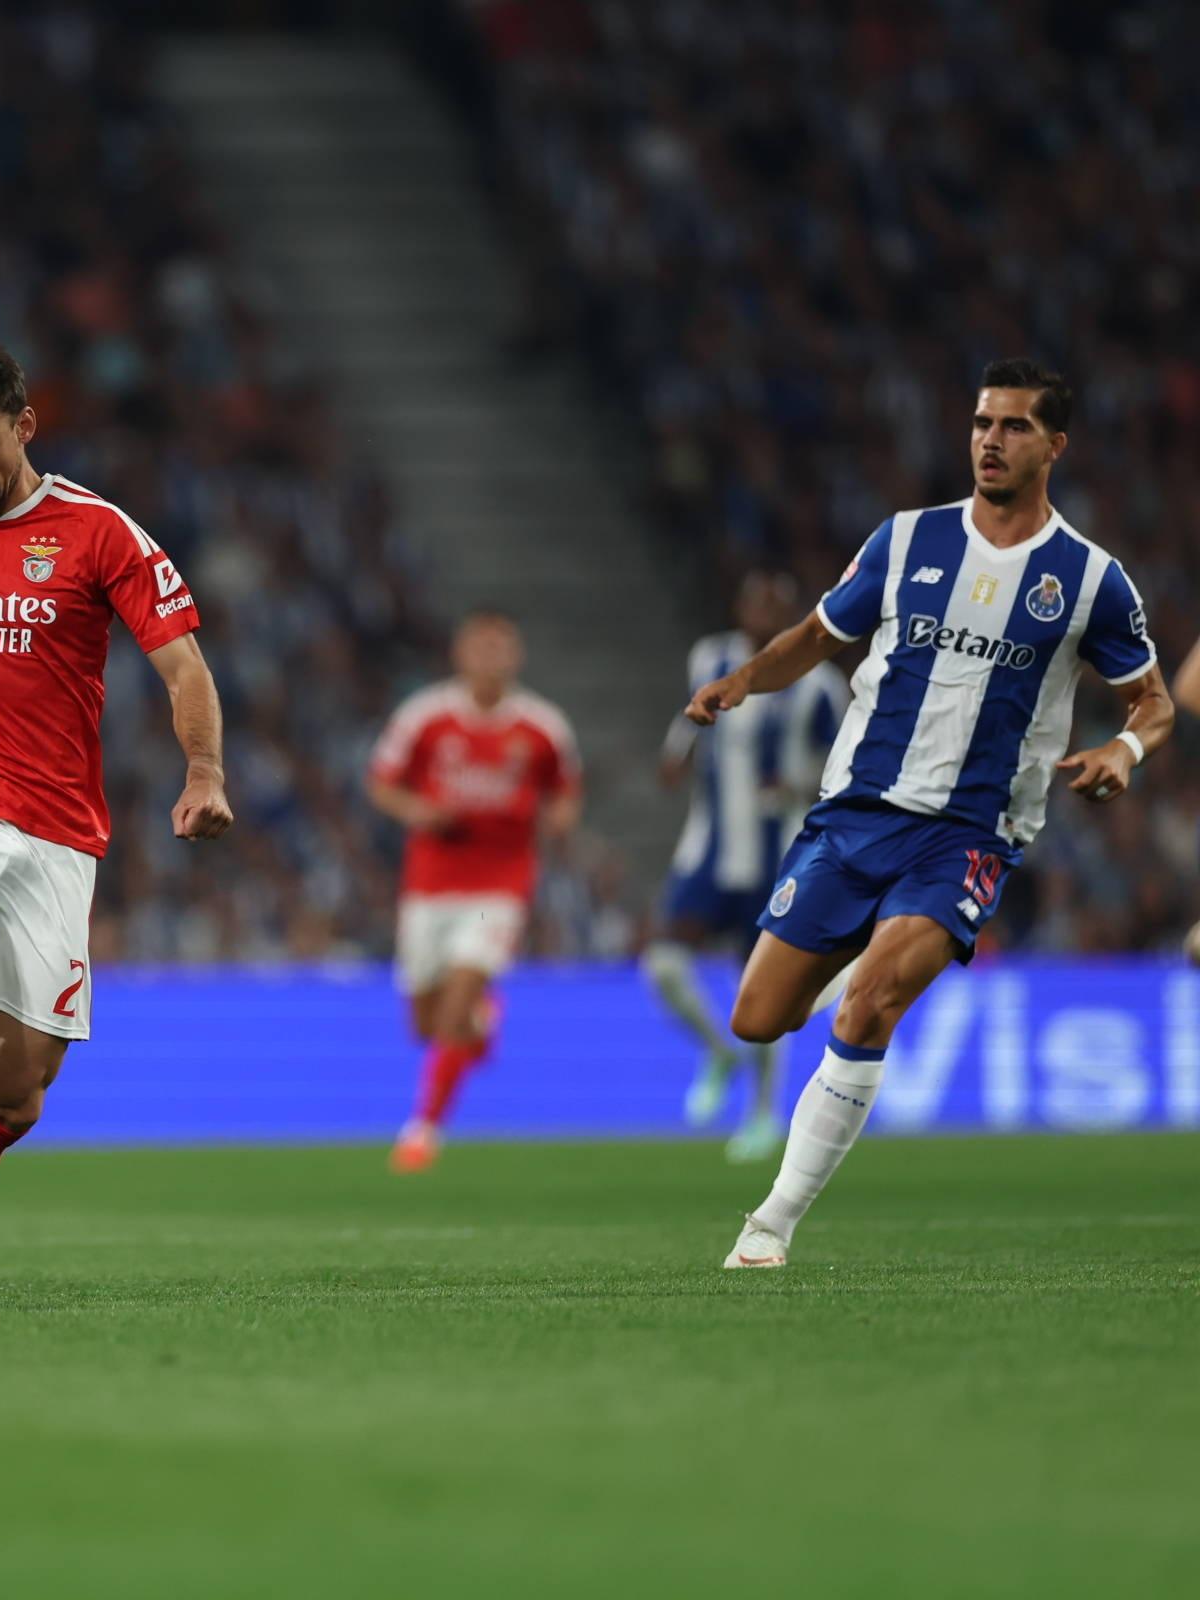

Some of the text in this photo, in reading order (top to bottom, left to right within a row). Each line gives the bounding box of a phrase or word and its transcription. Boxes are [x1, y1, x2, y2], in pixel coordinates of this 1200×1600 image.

[906, 613, 1035, 670] Betano
[963, 849, 1001, 905] 19
[52, 959, 84, 1018] 2
